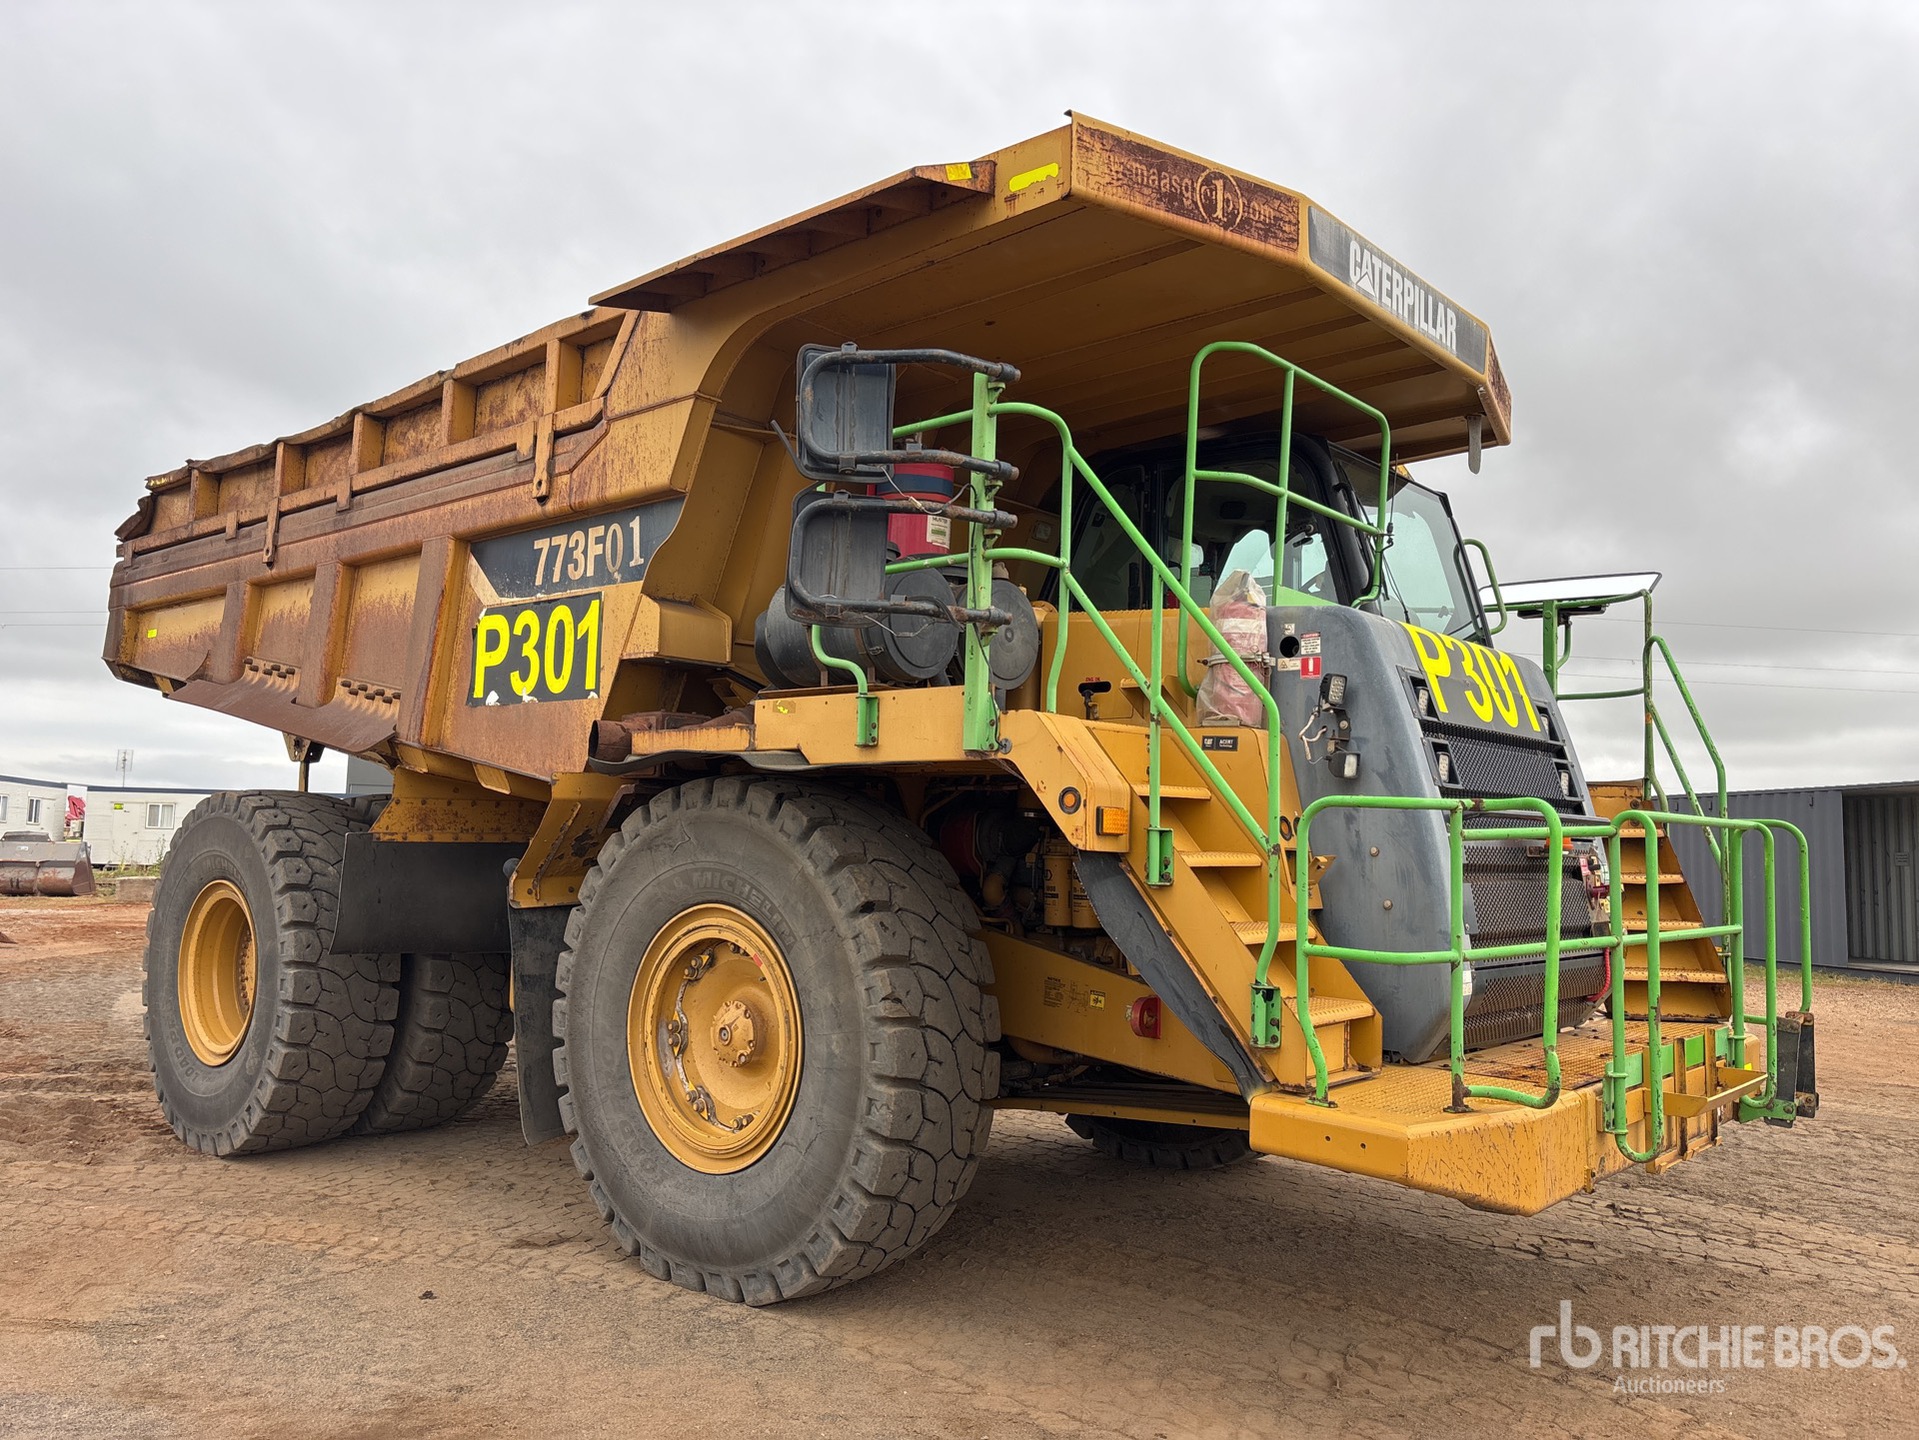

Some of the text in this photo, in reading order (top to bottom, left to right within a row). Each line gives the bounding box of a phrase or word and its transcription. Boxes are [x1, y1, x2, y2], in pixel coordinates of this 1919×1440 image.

[1349, 239, 1458, 353] CATERPILLAR
[533, 515, 645, 586] 773F01
[473, 599, 600, 699] P301
[1401, 621, 1541, 732] P301
